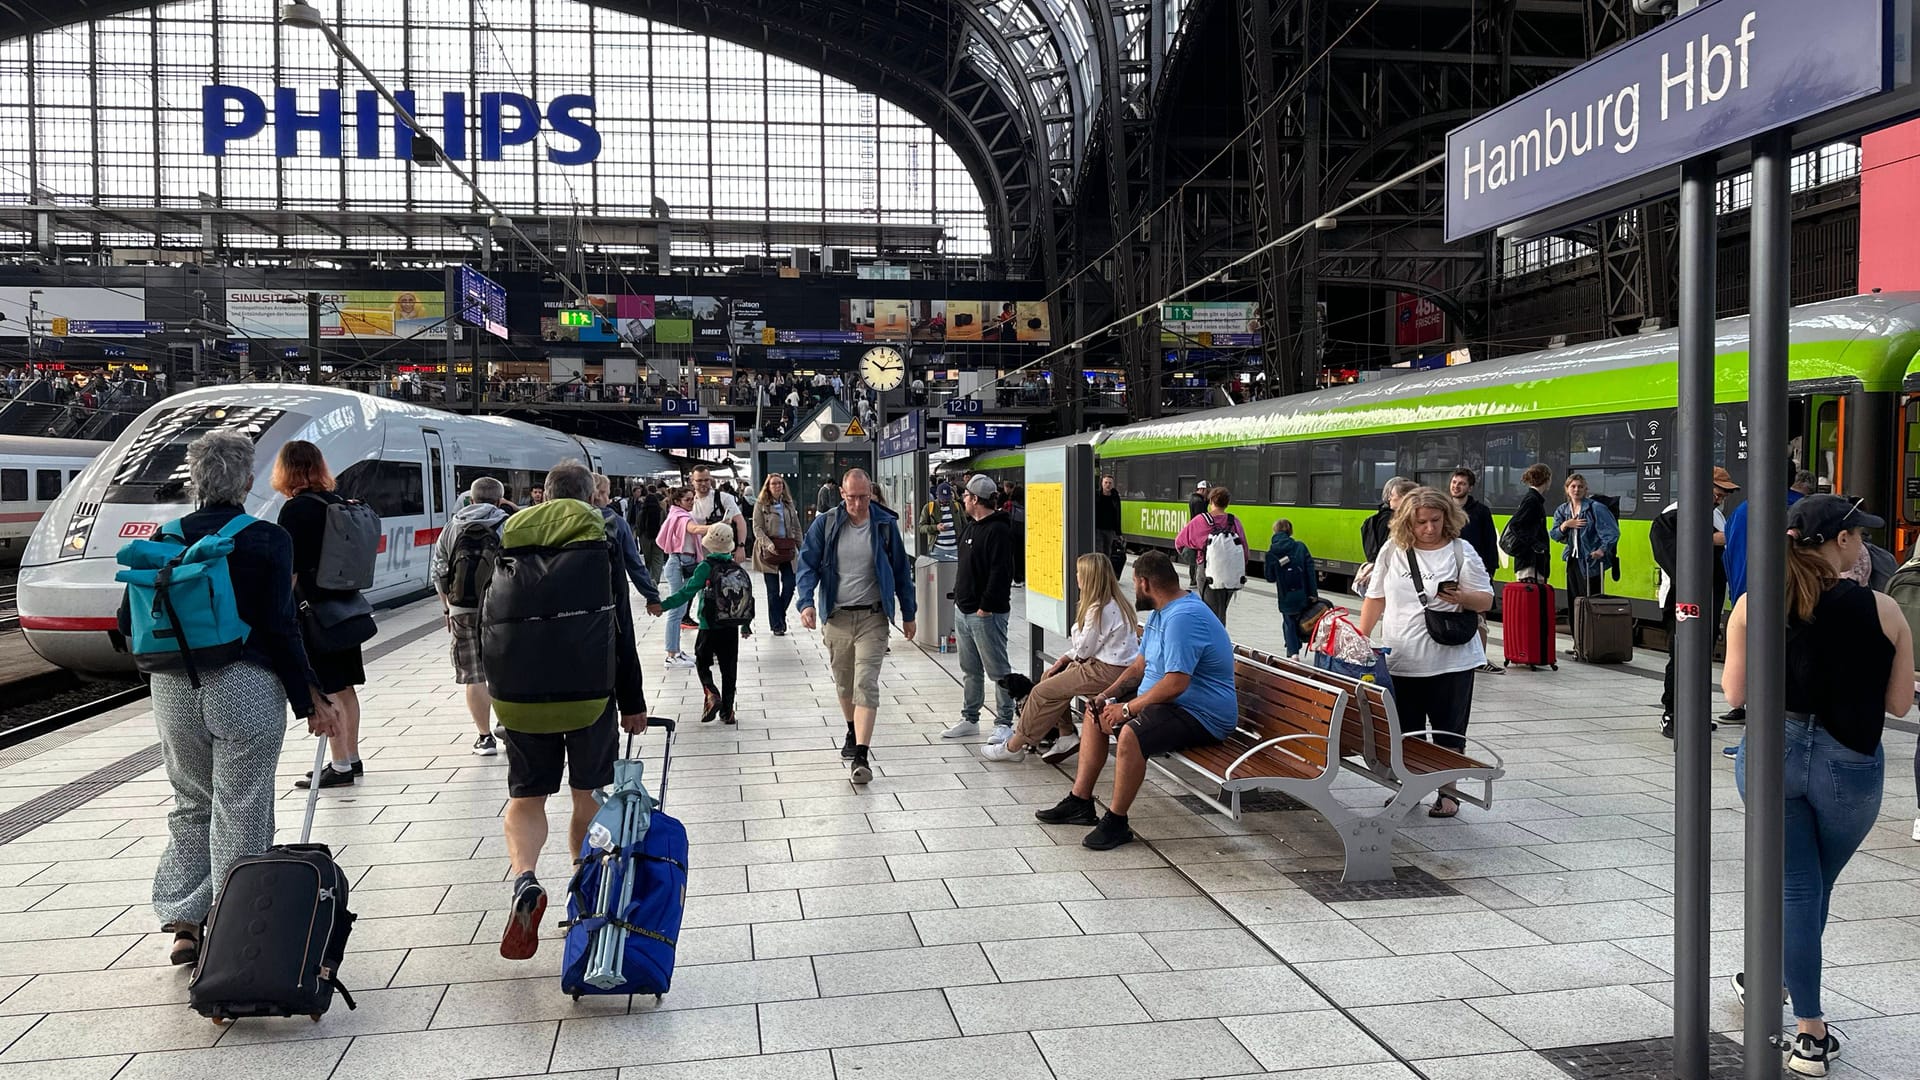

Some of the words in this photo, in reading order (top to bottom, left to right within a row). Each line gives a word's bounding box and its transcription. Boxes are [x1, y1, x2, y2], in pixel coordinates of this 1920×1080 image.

[1463, 82, 1641, 201] Hamburg
[1660, 11, 1757, 121] Hbf
[202, 84, 602, 166] PHILIPS
[1415, 313, 1441, 328] FRISCHE
[667, 399, 676, 412] D
[687, 400, 698, 412] 11
[949, 400, 962, 412] 12
[969, 400, 978, 412] D
[123, 524, 152, 536] DB
[386, 526, 414, 572] ICE
[1681, 605, 1699, 616] 48
